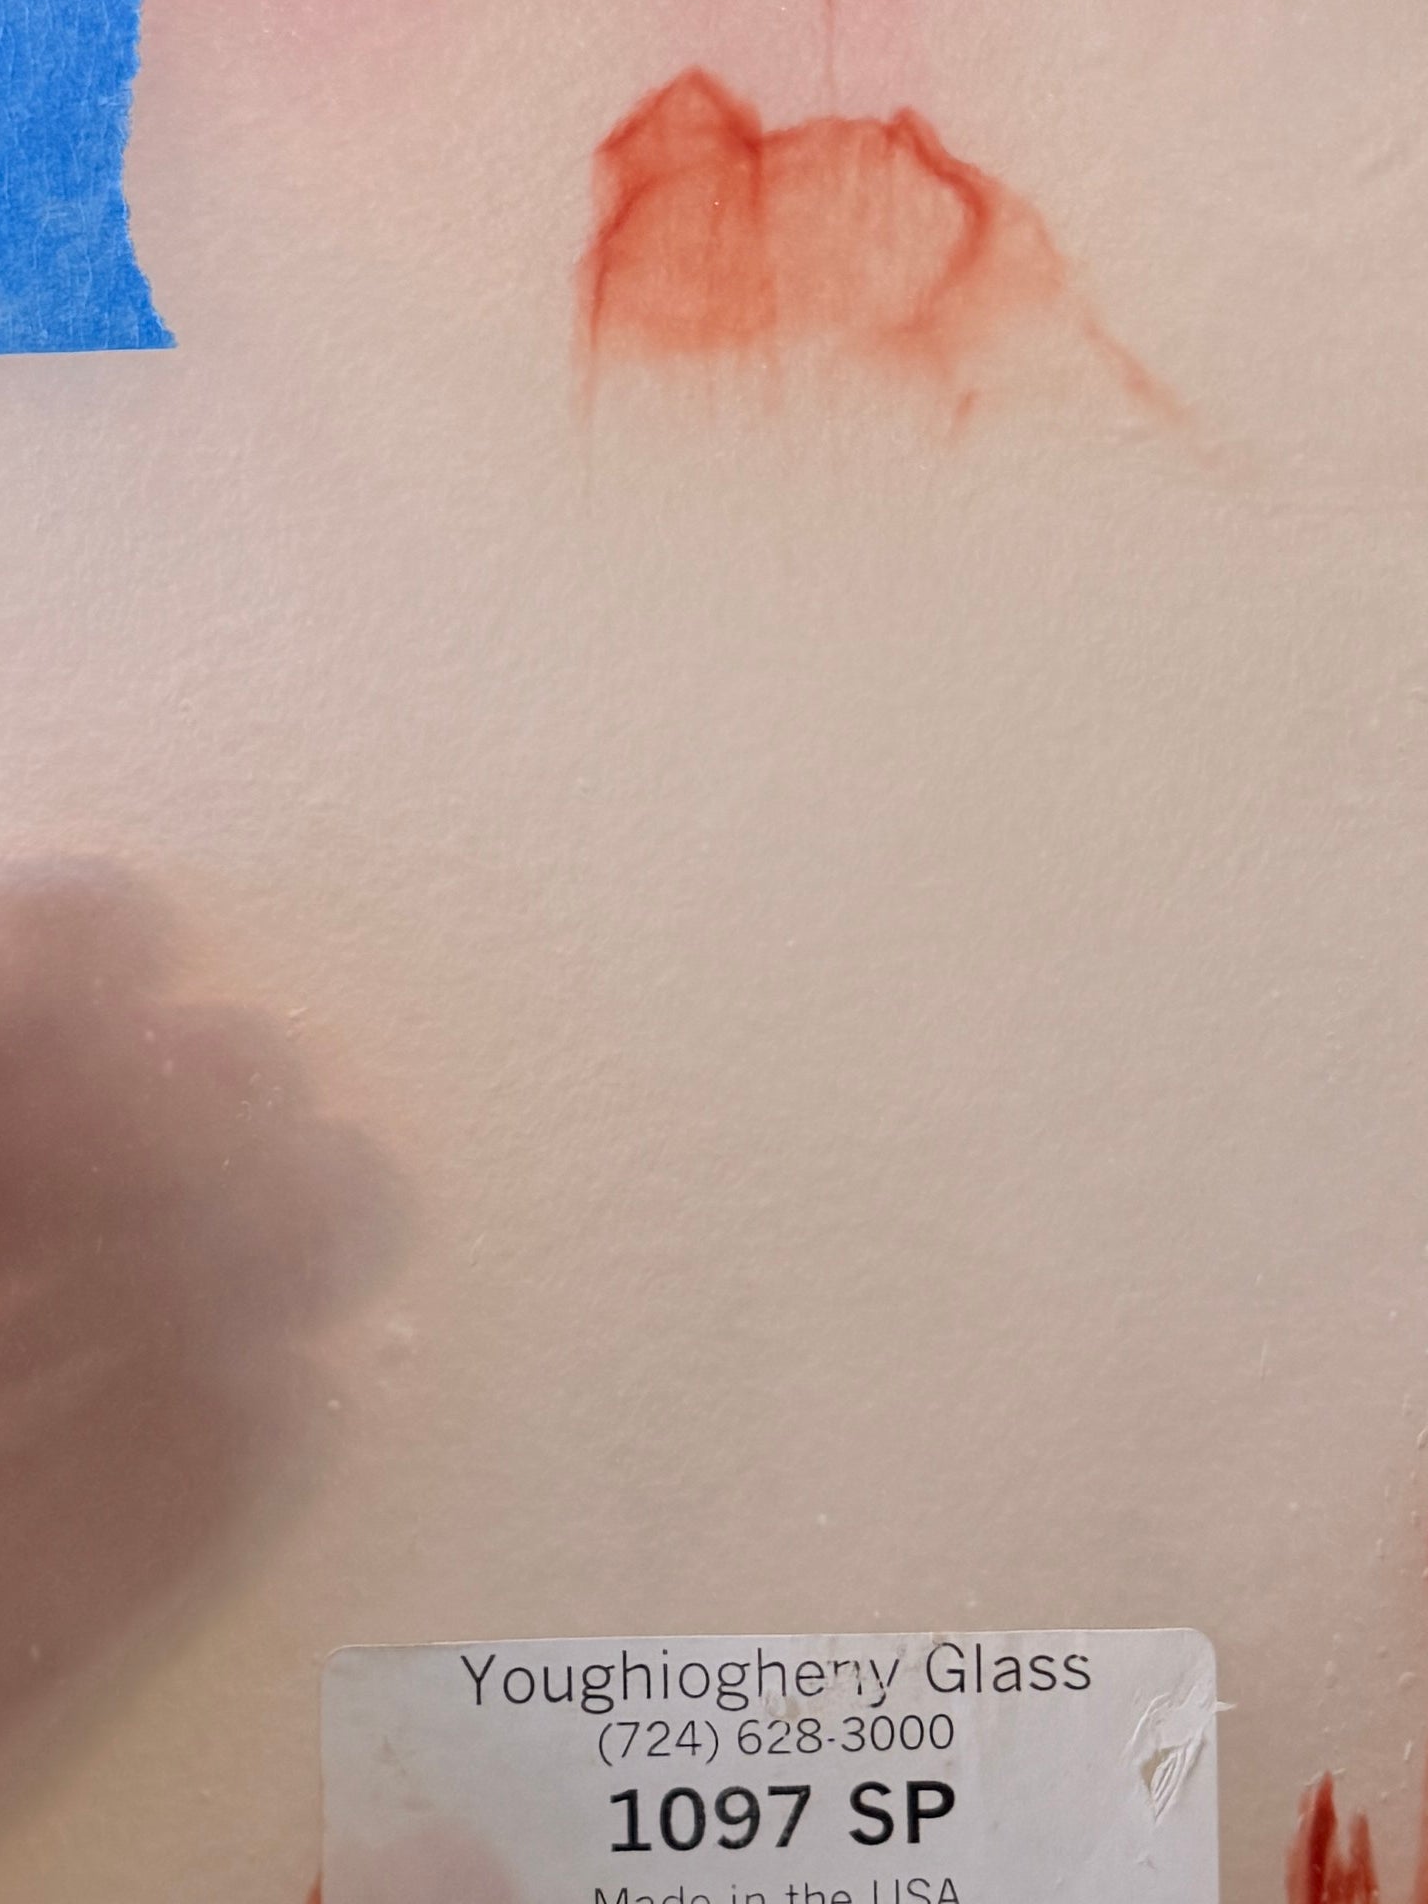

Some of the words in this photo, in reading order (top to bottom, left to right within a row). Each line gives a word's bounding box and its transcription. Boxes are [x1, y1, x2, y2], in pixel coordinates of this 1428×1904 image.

[926, 1642, 1093, 1695] Glass
[597, 1719, 720, 1767] (724)
[737, 1712, 956, 1756] 628-3000
[610, 1785, 812, 1853] 1097
[849, 1779, 957, 1847] SP
